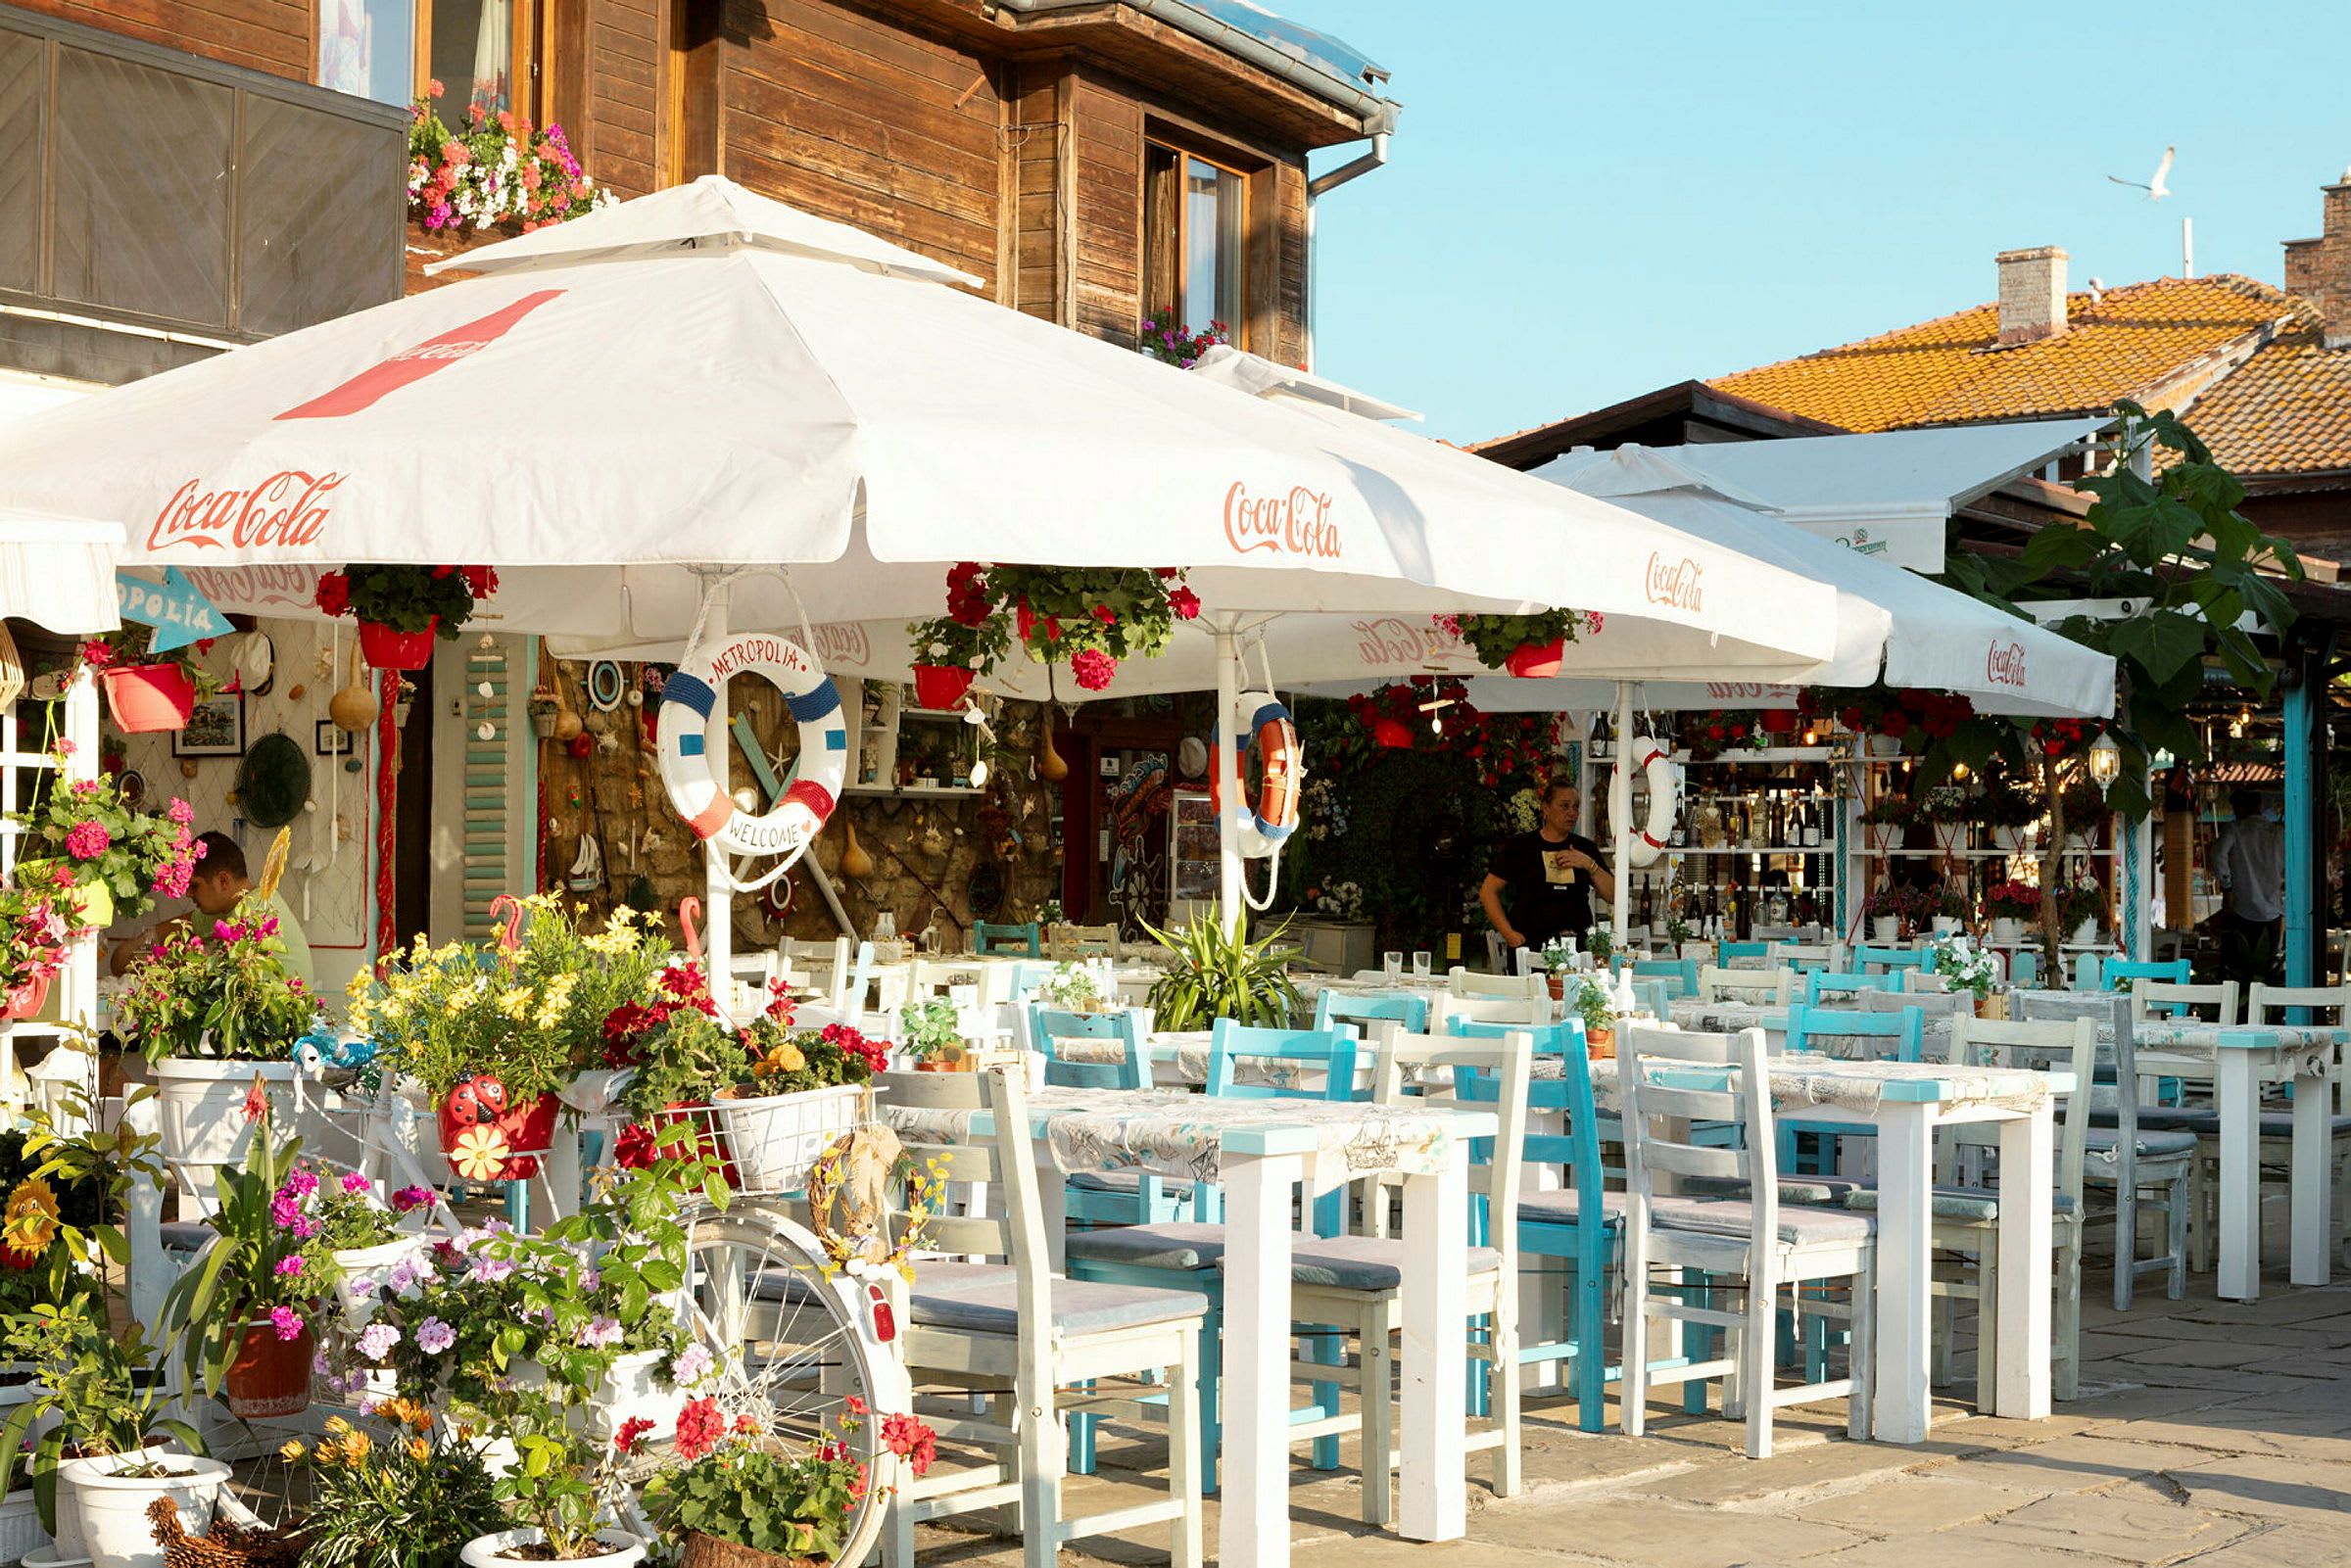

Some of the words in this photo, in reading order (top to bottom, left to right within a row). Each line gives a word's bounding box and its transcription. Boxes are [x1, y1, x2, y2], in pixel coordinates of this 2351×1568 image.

[147, 470, 352, 551] Coca-Cola
[1223, 481, 1342, 558] Coca-Cola
[1646, 550, 1703, 613] Coca-Cola
[710, 639, 799, 683] METROPOLIA
[1987, 639, 2026, 687] Coca-Cola
[729, 816, 799, 848] WELCOME
